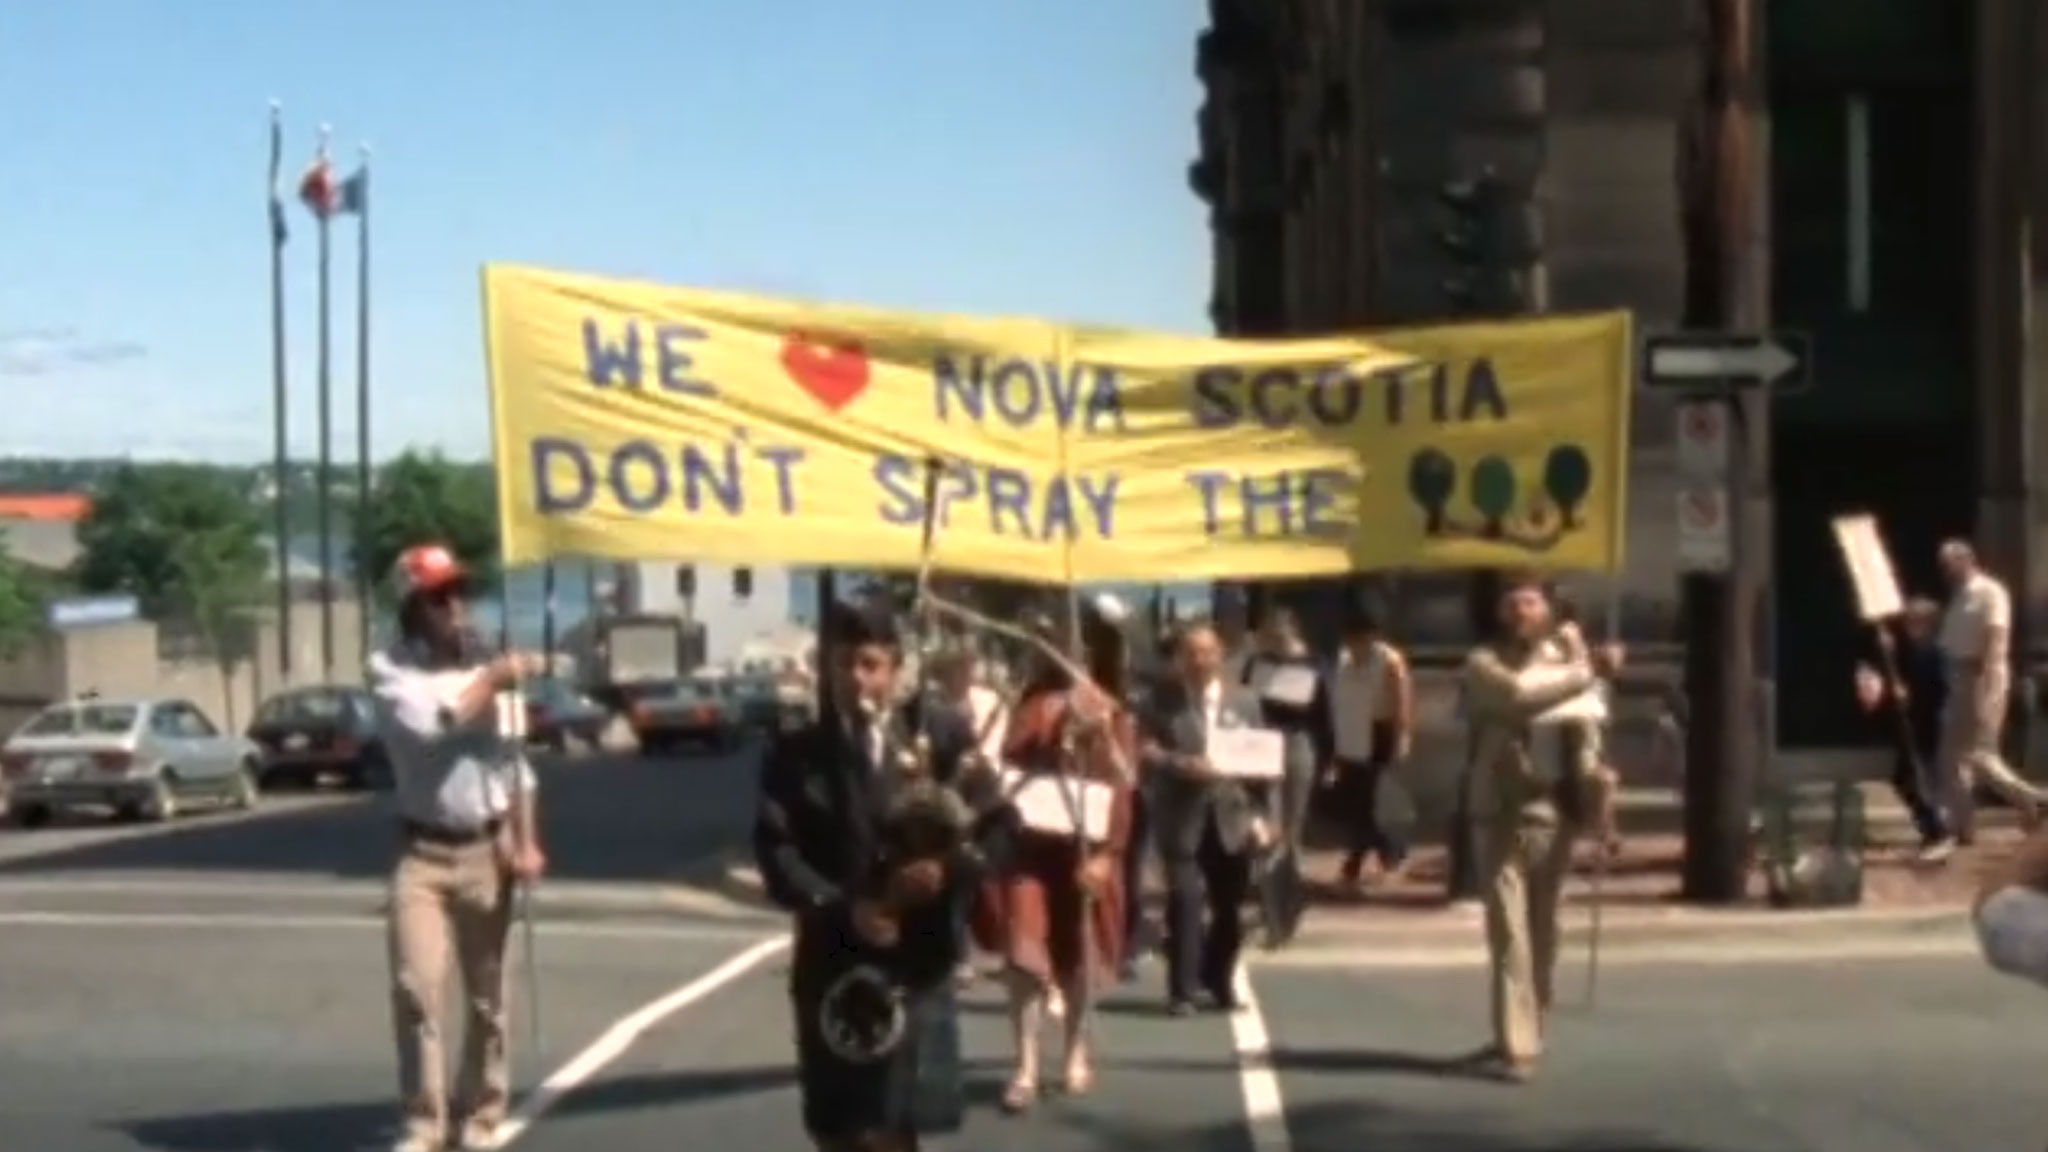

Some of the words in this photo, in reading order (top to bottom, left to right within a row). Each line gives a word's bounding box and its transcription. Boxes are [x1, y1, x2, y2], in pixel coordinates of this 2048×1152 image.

[583, 318, 717, 396] WE
[934, 356, 1125, 431] NOVA
[1195, 358, 1505, 429] SCOTIA
[532, 427, 804, 514] DON'T
[873, 453, 1120, 539] SPRAY
[1187, 469, 1351, 538] THE
